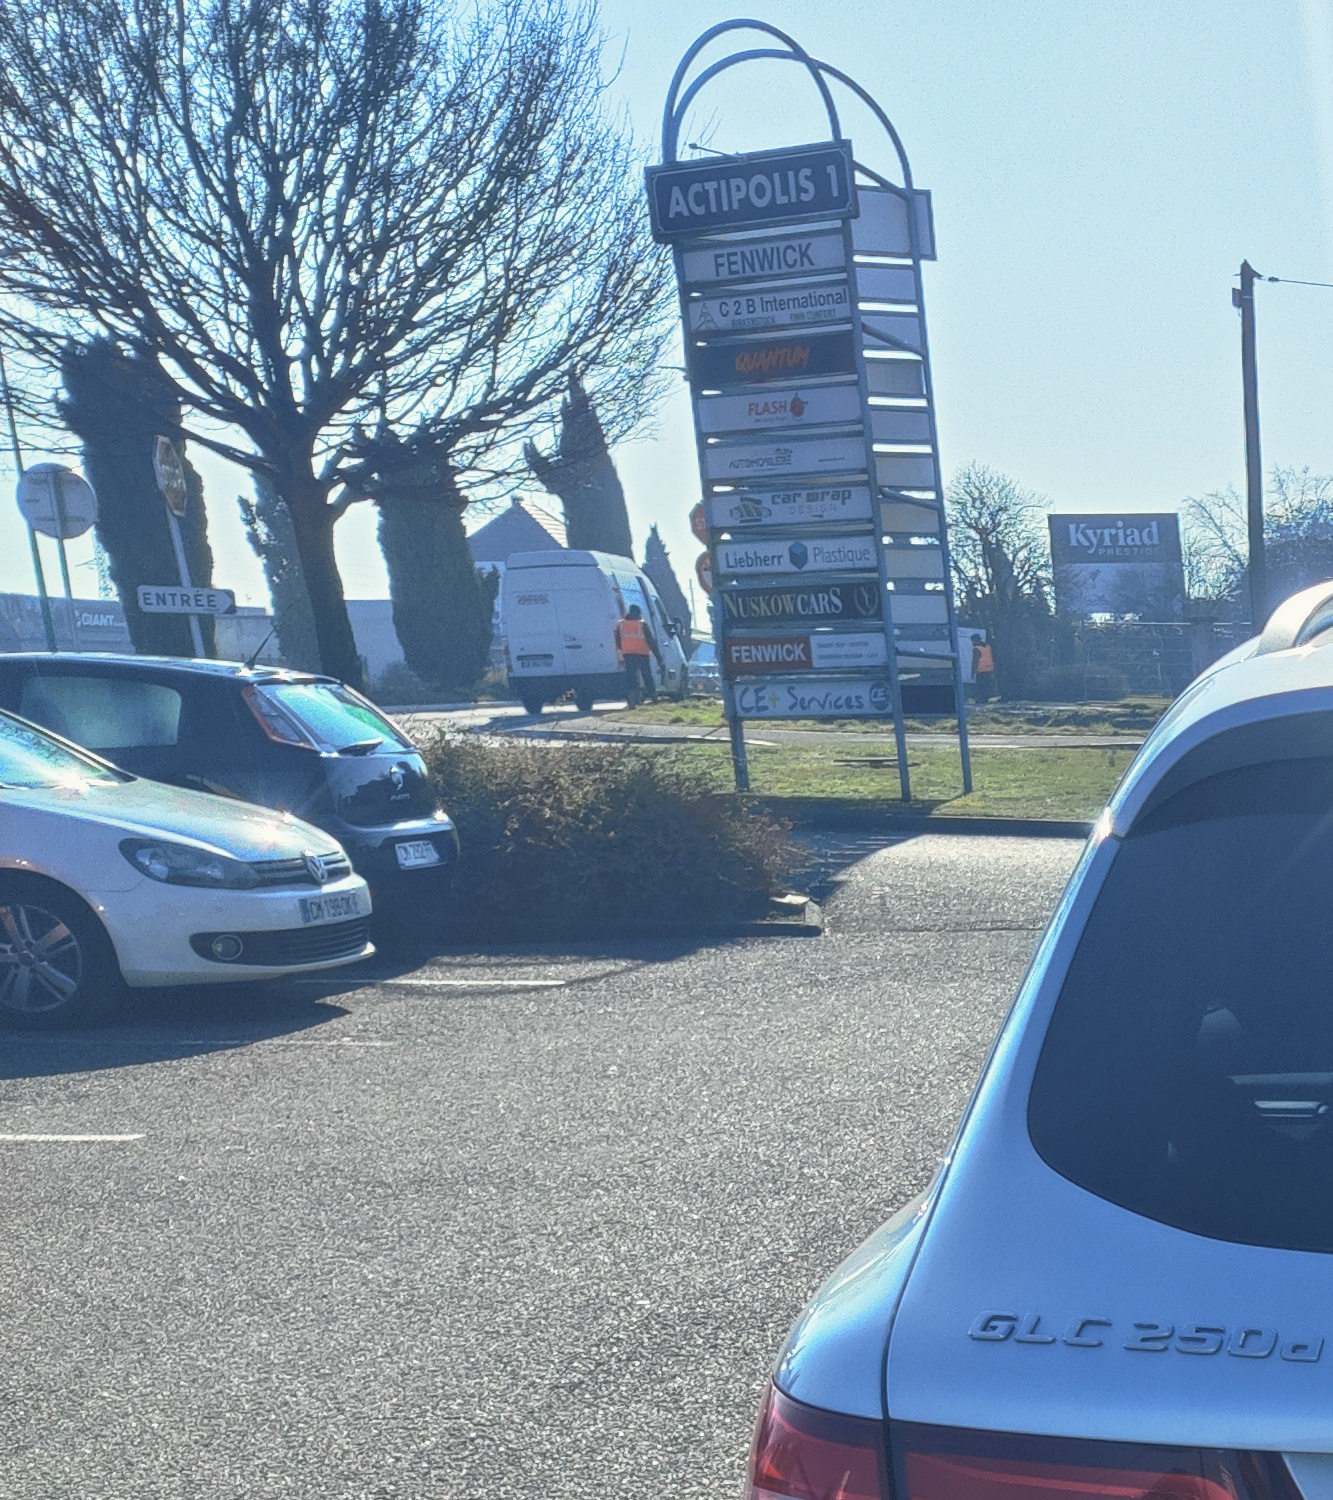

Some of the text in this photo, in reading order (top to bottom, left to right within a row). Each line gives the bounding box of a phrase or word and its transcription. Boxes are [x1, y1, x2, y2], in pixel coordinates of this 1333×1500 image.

[668, 165, 839, 219] ACTIPOLIS 1
[713, 242, 815, 278] FENWICK
[719, 288, 848, 317] C 2 B International
[748, 400, 787, 416] FLASH
[771, 489, 852, 506] car wrap
[1068, 521, 1160, 554] Kyriad
[725, 547, 871, 569] Liebherr Plastique
[142, 590, 218, 608] ENTRÉE
[731, 643, 807, 663] FENWICK
[787, 686, 864, 711] Services
[967, 1310, 1325, 1362] GLC 250d
